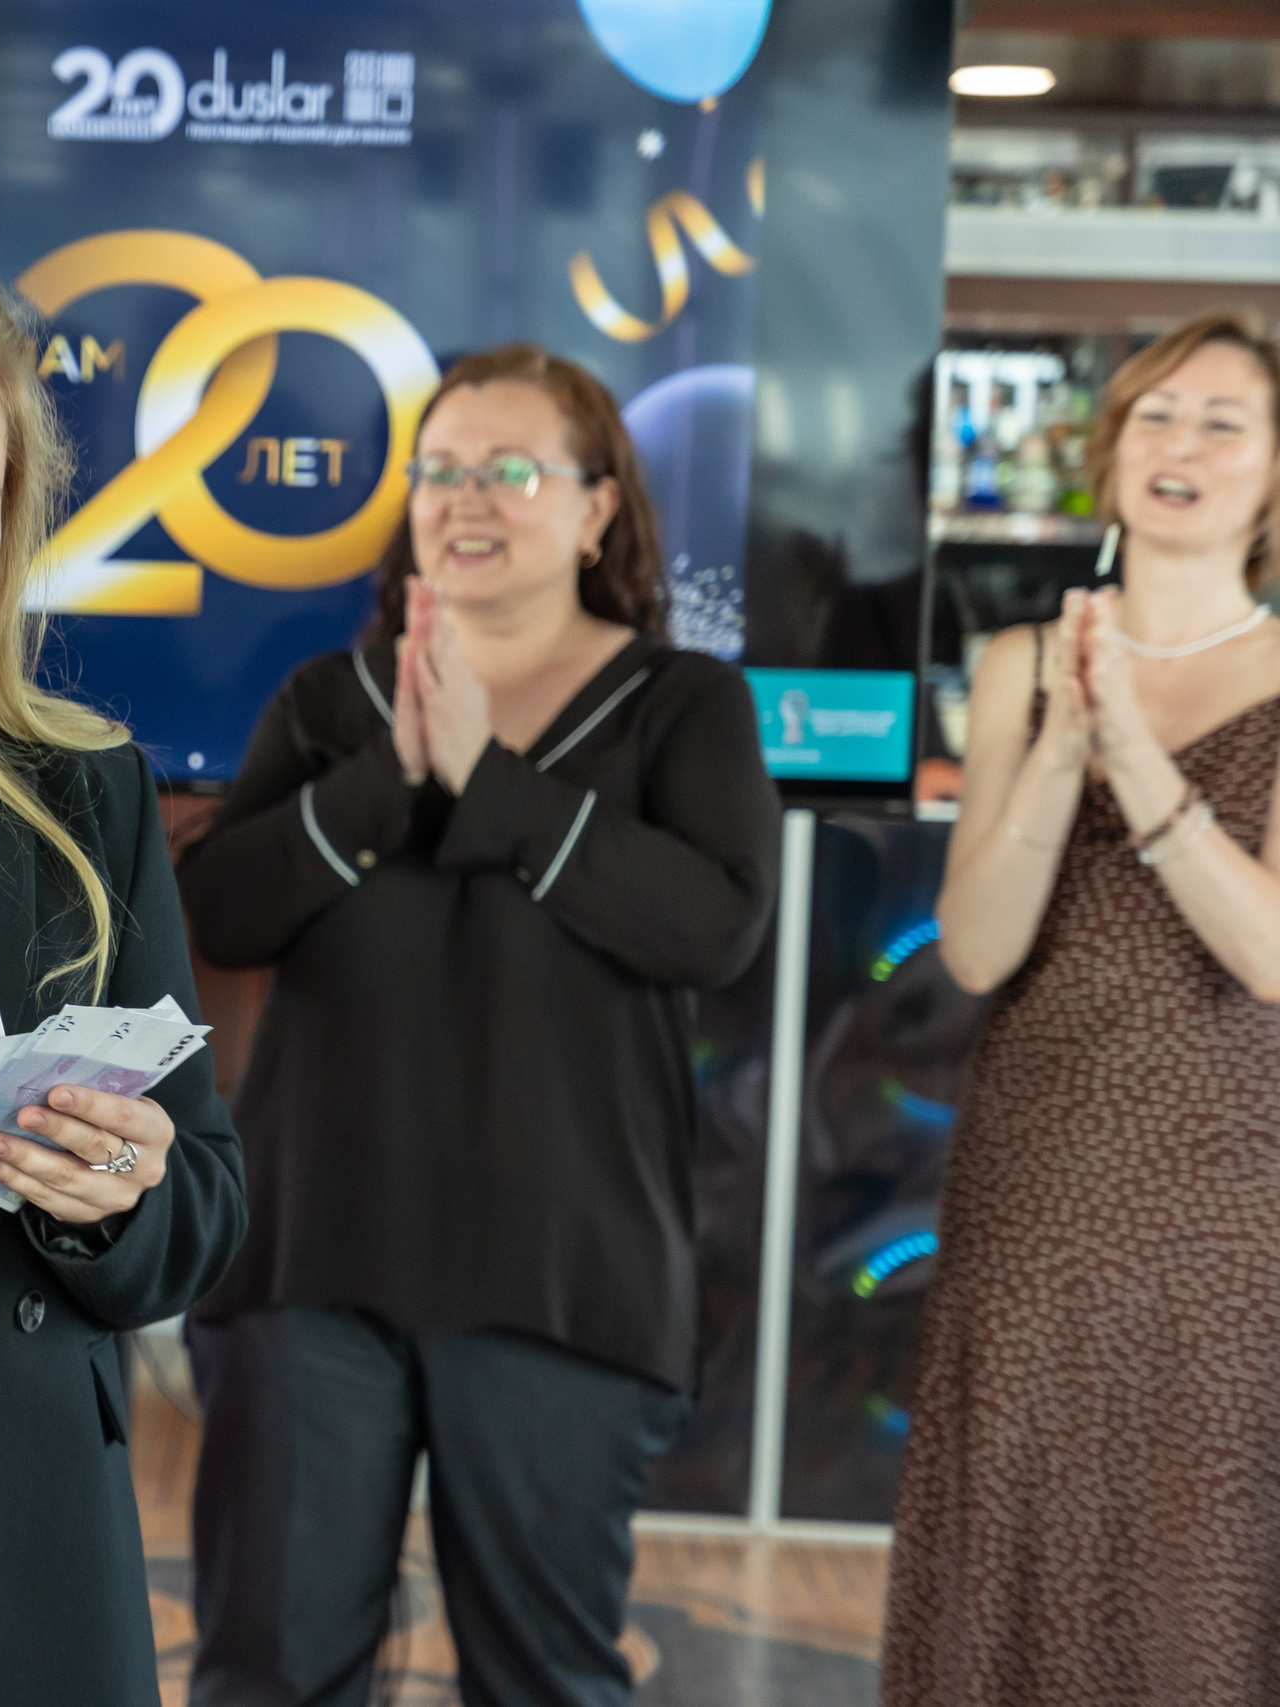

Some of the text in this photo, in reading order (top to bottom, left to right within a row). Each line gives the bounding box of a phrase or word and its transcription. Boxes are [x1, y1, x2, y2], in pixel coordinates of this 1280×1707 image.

[23, 334, 125, 384] АМ
[16, 229, 442, 617] 20
[239, 437, 349, 487] ЛЕТ
